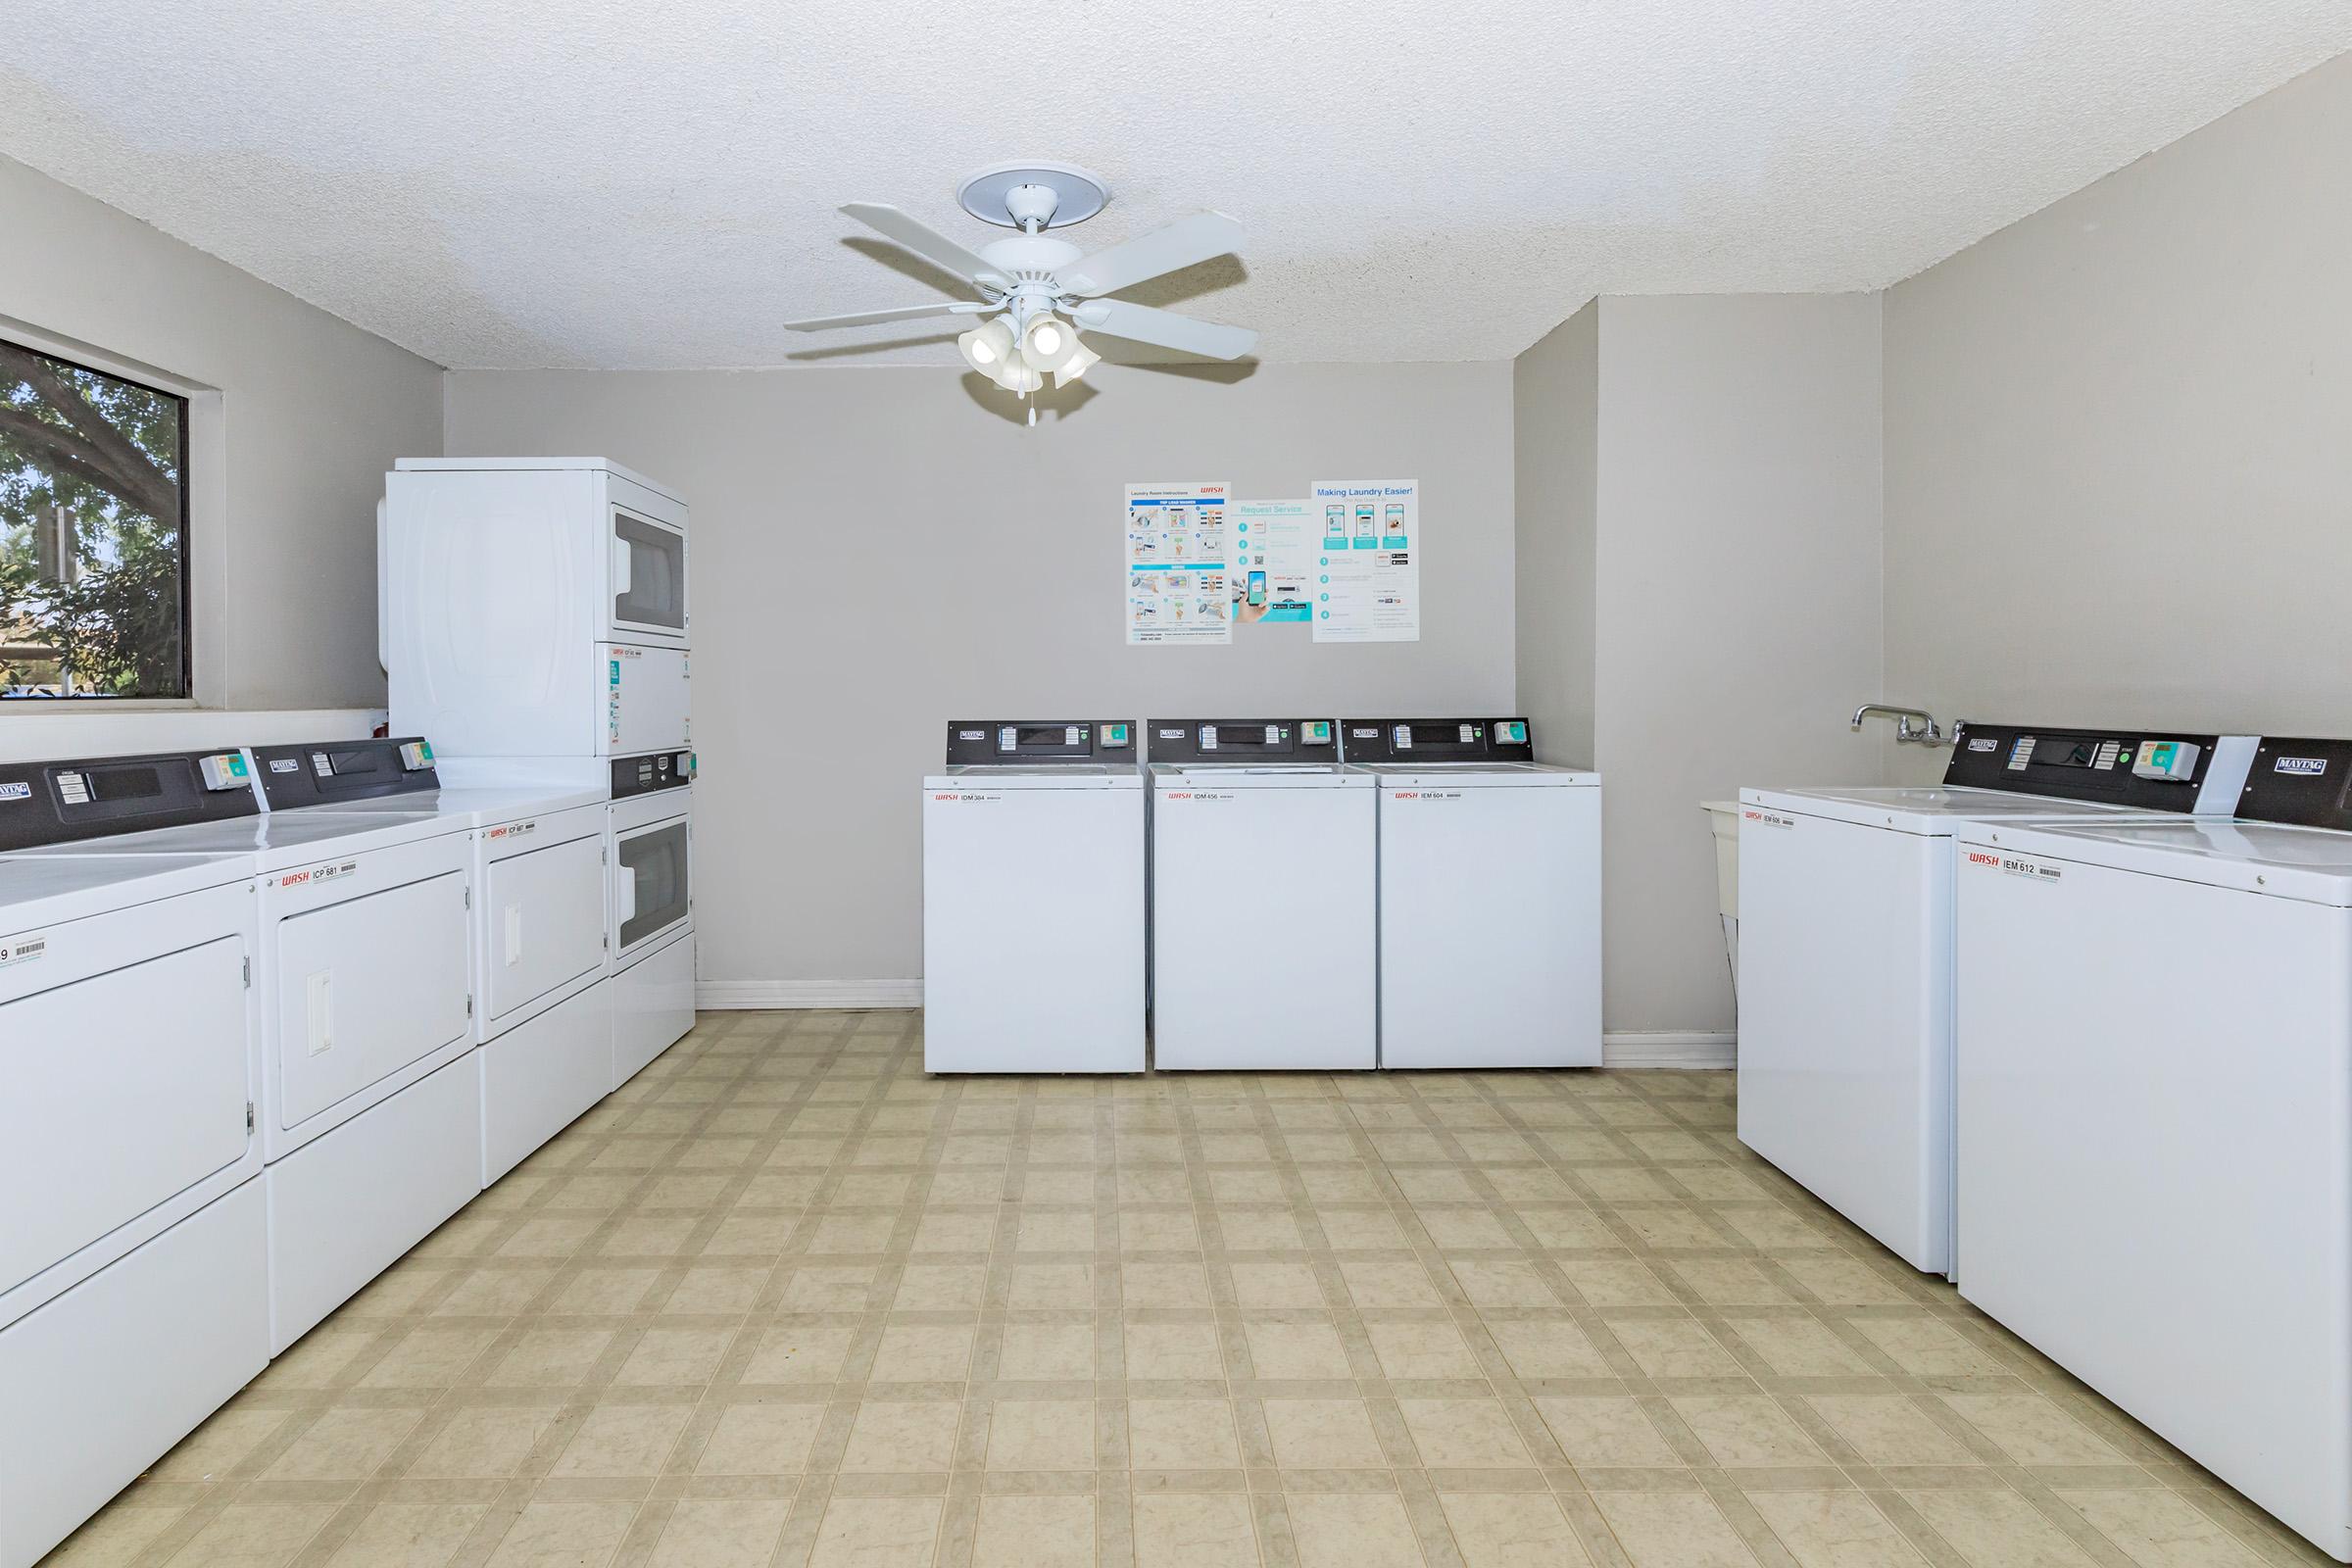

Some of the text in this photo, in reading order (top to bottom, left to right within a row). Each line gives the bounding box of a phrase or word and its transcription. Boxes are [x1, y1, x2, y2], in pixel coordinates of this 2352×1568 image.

[1317, 489, 1347, 498] Making
[1348, 488, 1382, 497] Laundry
[1241, 506, 1272, 514] Request
[272, 760, 297, 768] MAYTAG
[2278, 759, 2323, 769] MAYTAG
[0, 784, 27, 794] AYTAG
[1969, 853, 2034, 874] WASH IEM 612
[282, 867, 337, 887] WASH ICP 681
[0, 950, 8, 960] 9
